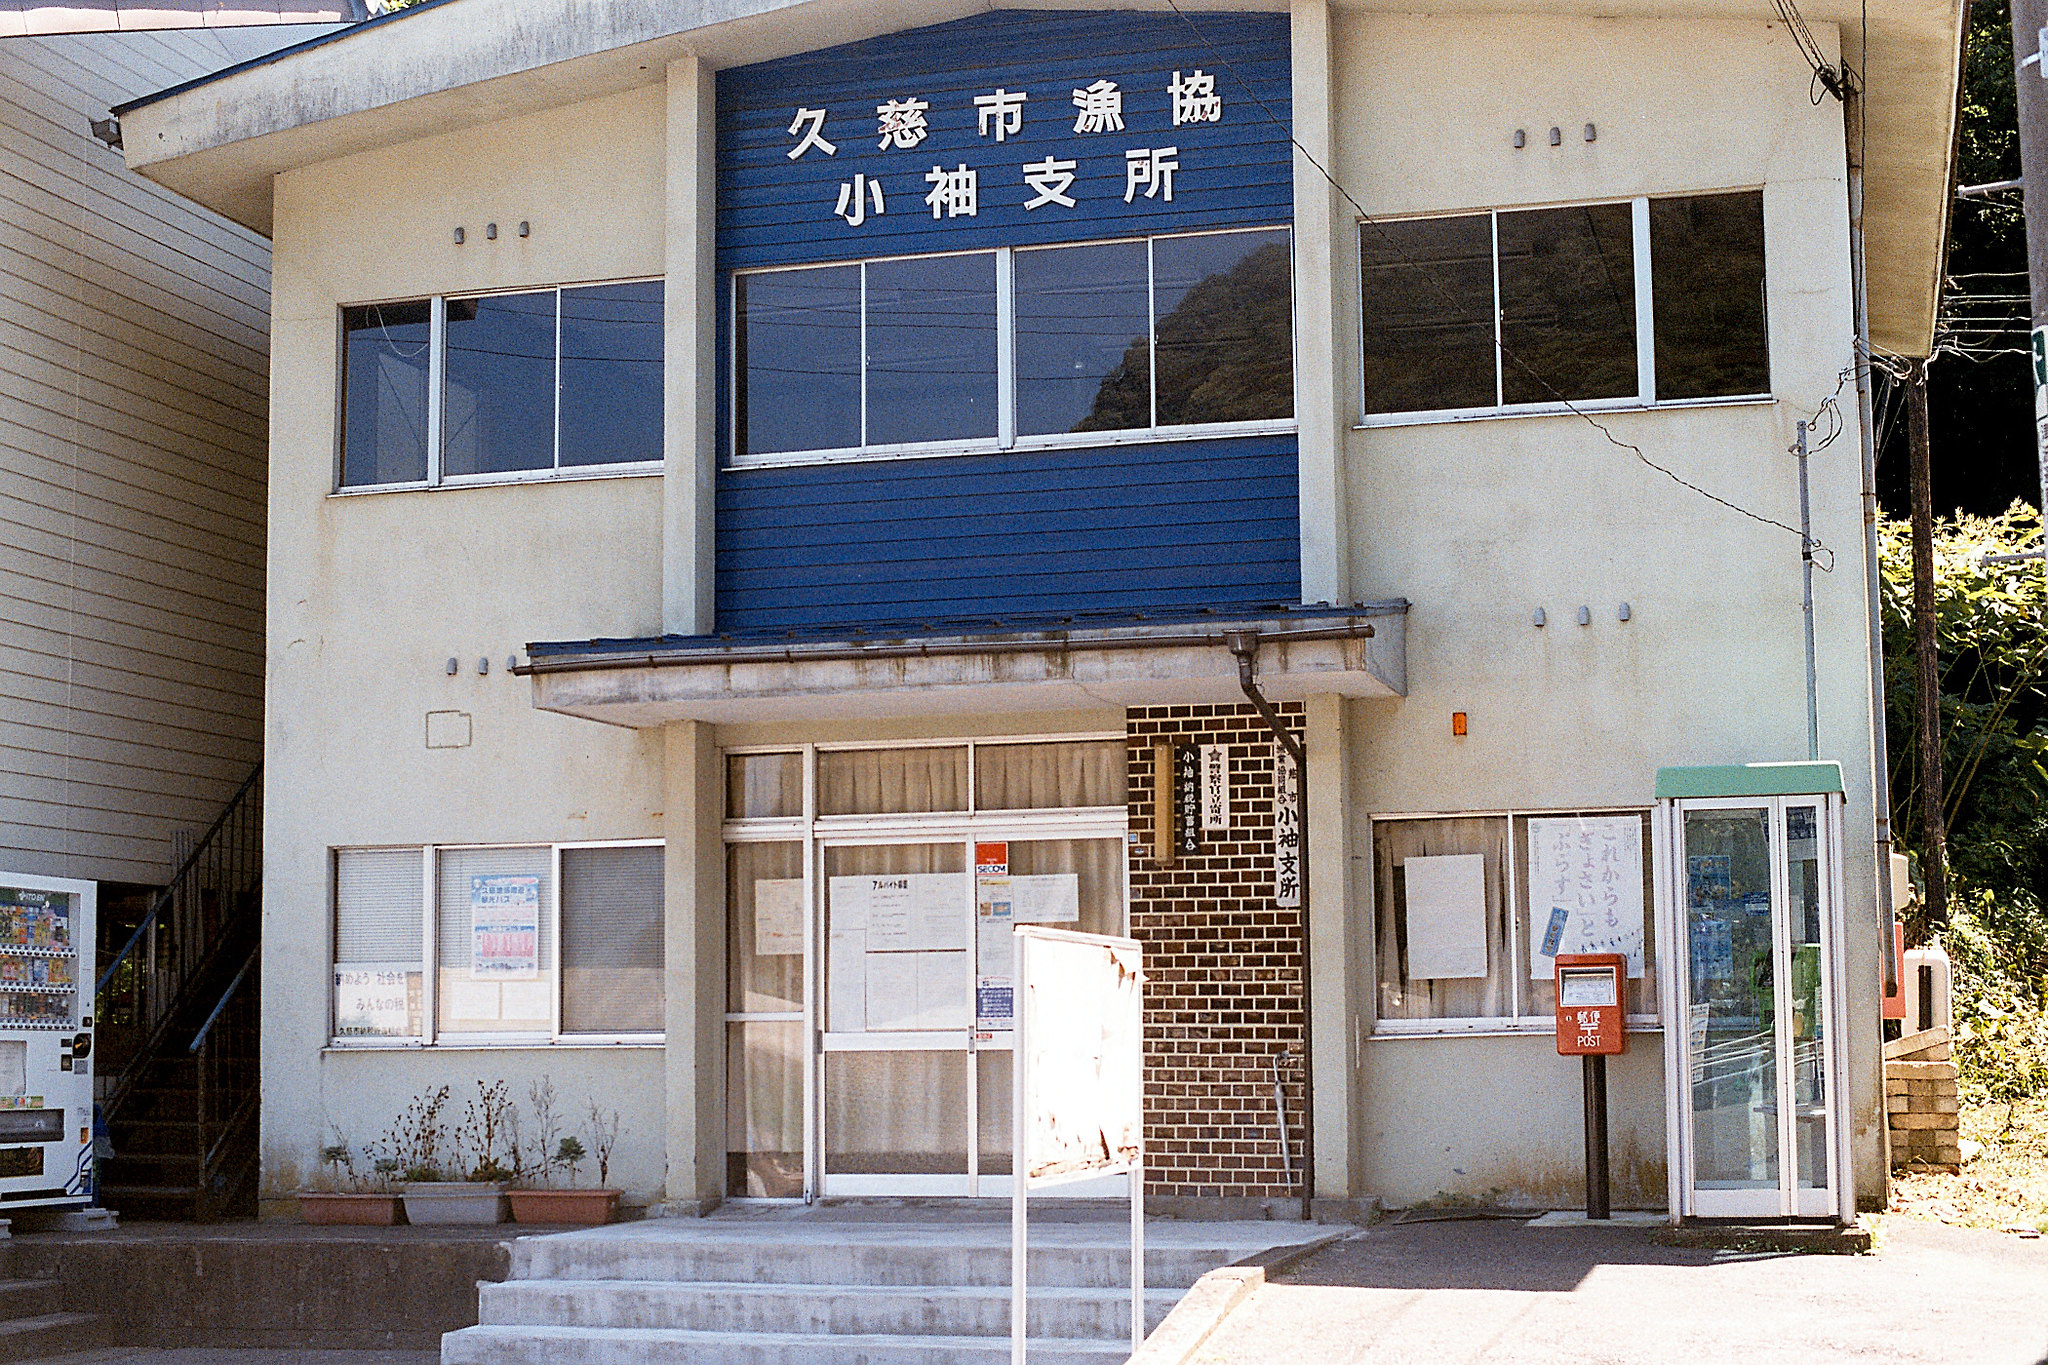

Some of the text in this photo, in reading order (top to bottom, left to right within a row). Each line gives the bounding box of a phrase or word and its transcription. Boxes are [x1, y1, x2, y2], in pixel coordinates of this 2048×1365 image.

[787, 70, 1222, 160] 久慈市漁協
[834, 147, 1179, 227] 小袖支所
[977, 864, 1006, 874] SECOM
[1277, 807, 1299, 899] 小袖支所
[1577, 1010, 1601, 1024] 郵便
[1577, 1035, 1601, 1047] POST
